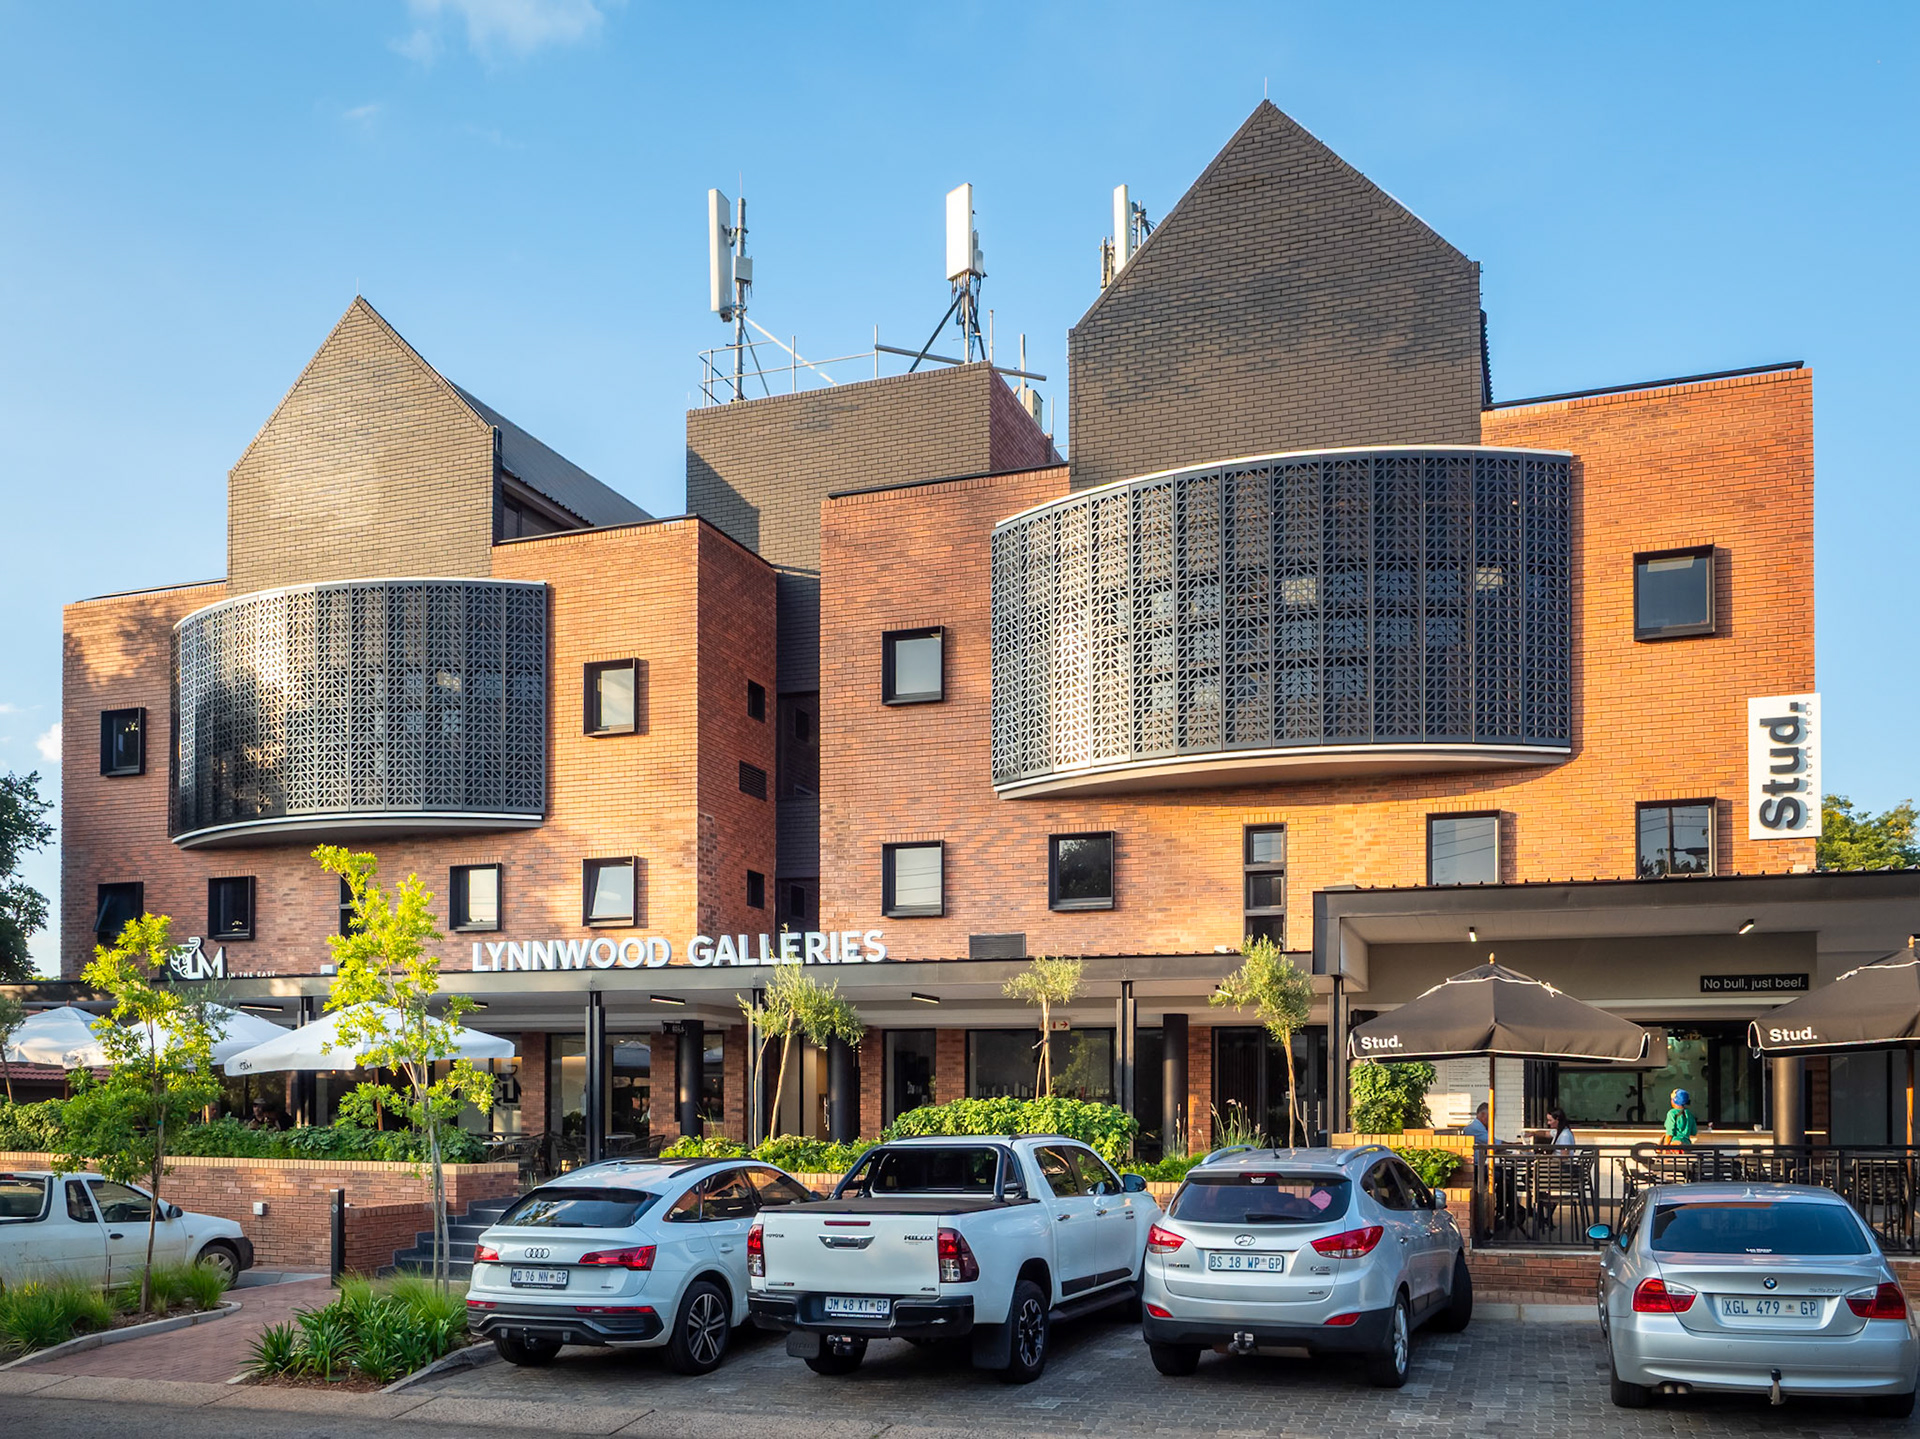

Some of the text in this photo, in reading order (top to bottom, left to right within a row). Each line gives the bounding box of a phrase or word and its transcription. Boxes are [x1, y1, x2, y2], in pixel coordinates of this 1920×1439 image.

[1759, 702, 1801, 829] Stud.
[1805, 702, 1813, 829] THE BURGER SHOP
[472, 929, 888, 972] LYNNWOOD GALLERIES
[1703, 976, 1805, 990] No bull, just beef.
[1769, 1026, 1818, 1042] Stud.
[1360, 1034, 1403, 1050] Stud.
[903, 1233, 934, 1241] HILUX
[1210, 1255, 1281, 1270] BS 18 WP GP
[525, 1271, 535, 1282] 96
[538, 1271, 549, 1283] NN
[556, 1272, 567, 1283] GP
[827, 1298, 887, 1312] JM 48 XT GP
[1724, 1300, 1816, 1315] XGL 479 GP
